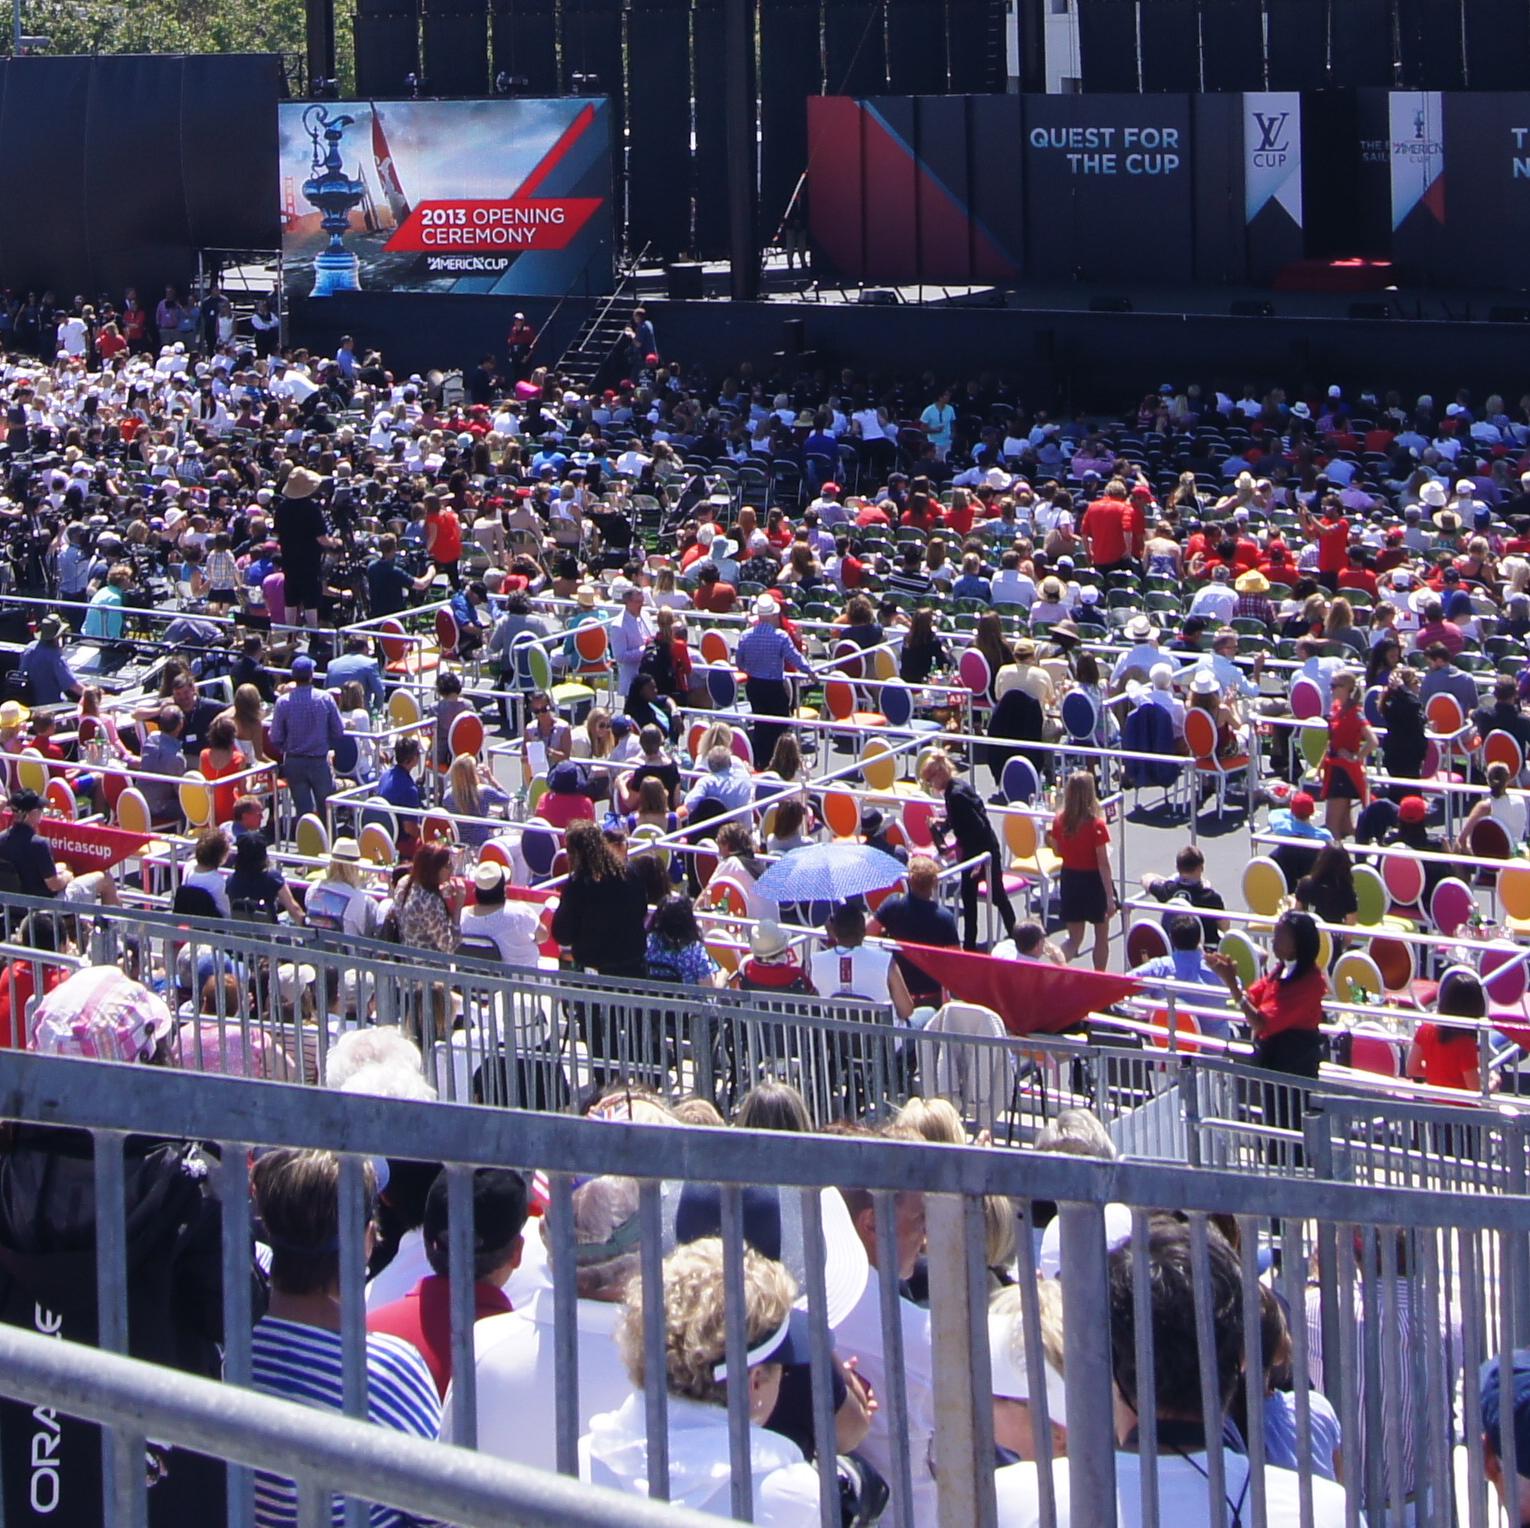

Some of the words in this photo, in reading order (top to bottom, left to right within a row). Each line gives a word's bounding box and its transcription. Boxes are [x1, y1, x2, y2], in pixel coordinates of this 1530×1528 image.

[1029, 127, 1115, 149] QUEST
[1123, 127, 1180, 149] FOR
[1359, 140, 1382, 151] THE
[1066, 153, 1117, 174] THE
[1125, 153, 1180, 175] CUP
[1252, 153, 1287, 168] CUP
[1362, 152, 1388, 162] SAIL
[421, 208, 466, 225] 2013
[473, 207, 565, 225] OPENING
[422, 227, 537, 245] CEREMONY
[484, 258, 509, 270] CUP
[49, 836, 112, 860] ericascup
[30, 1300, 63, 1513] ORAE
